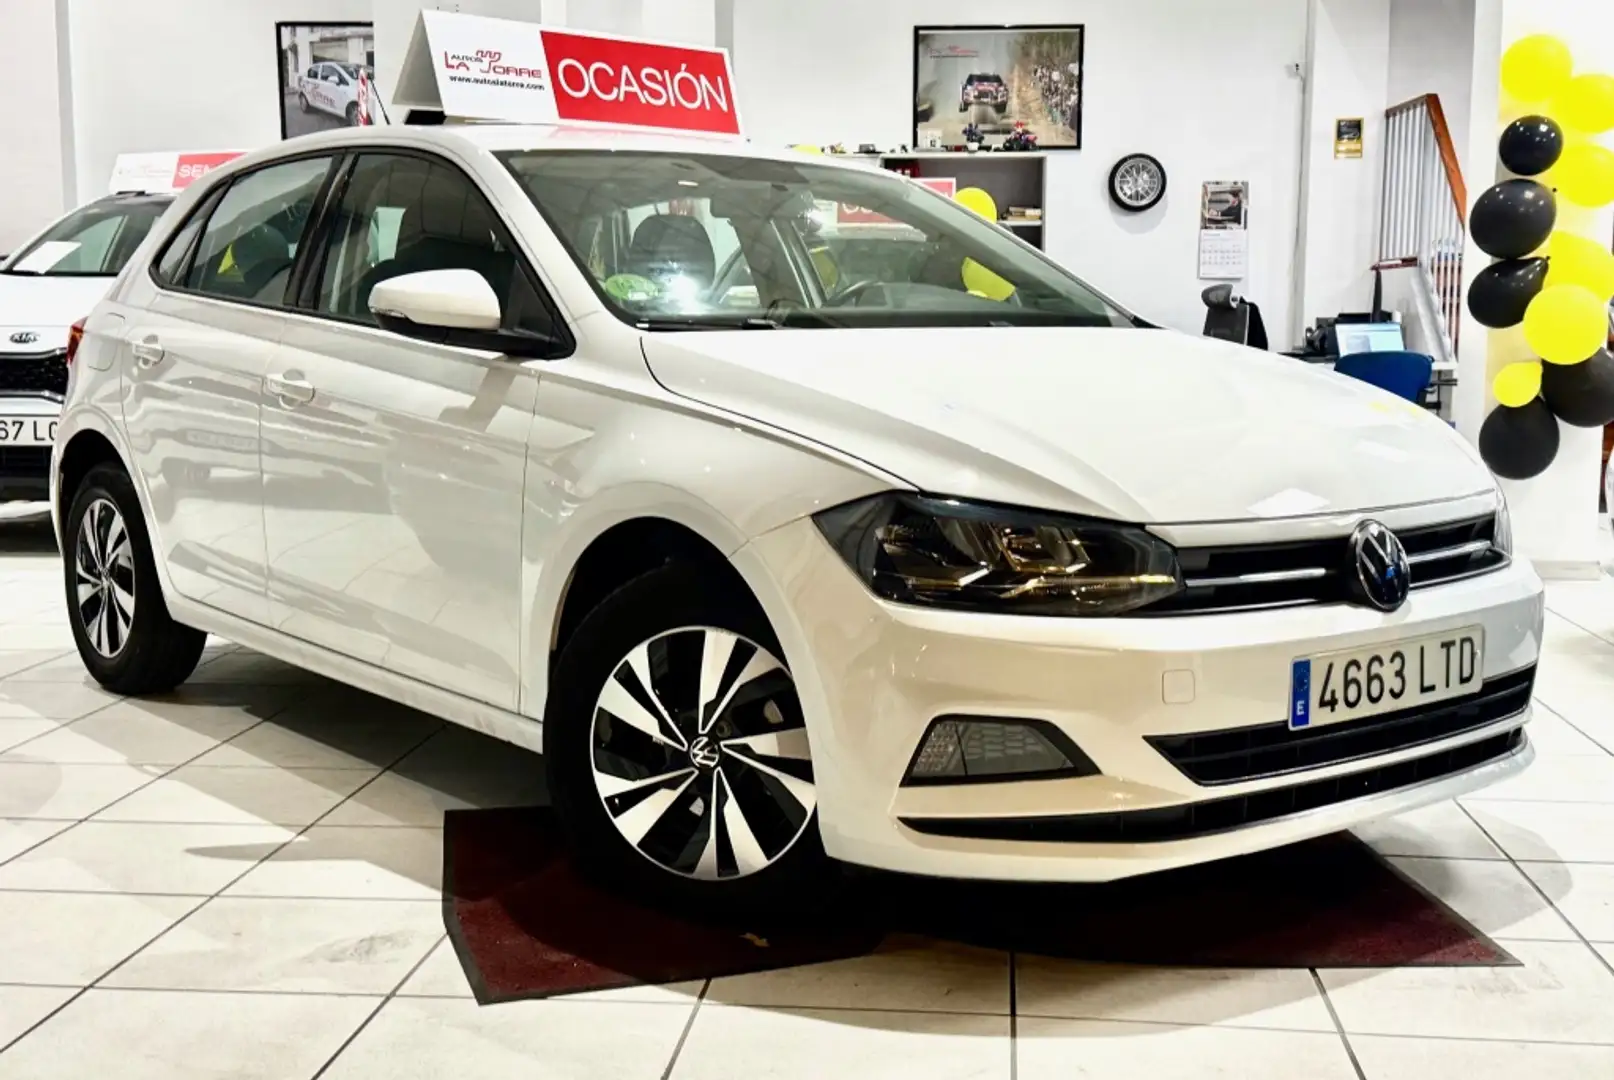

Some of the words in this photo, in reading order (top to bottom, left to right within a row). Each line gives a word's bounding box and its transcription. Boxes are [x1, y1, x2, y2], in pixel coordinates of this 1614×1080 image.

[444, 51, 470, 71] LA
[557, 58, 728, 112] OCASIÓN
[1296, 701, 1305, 716] E
[1319, 650, 1406, 713] 4663
[1420, 636, 1475, 694] LTD
